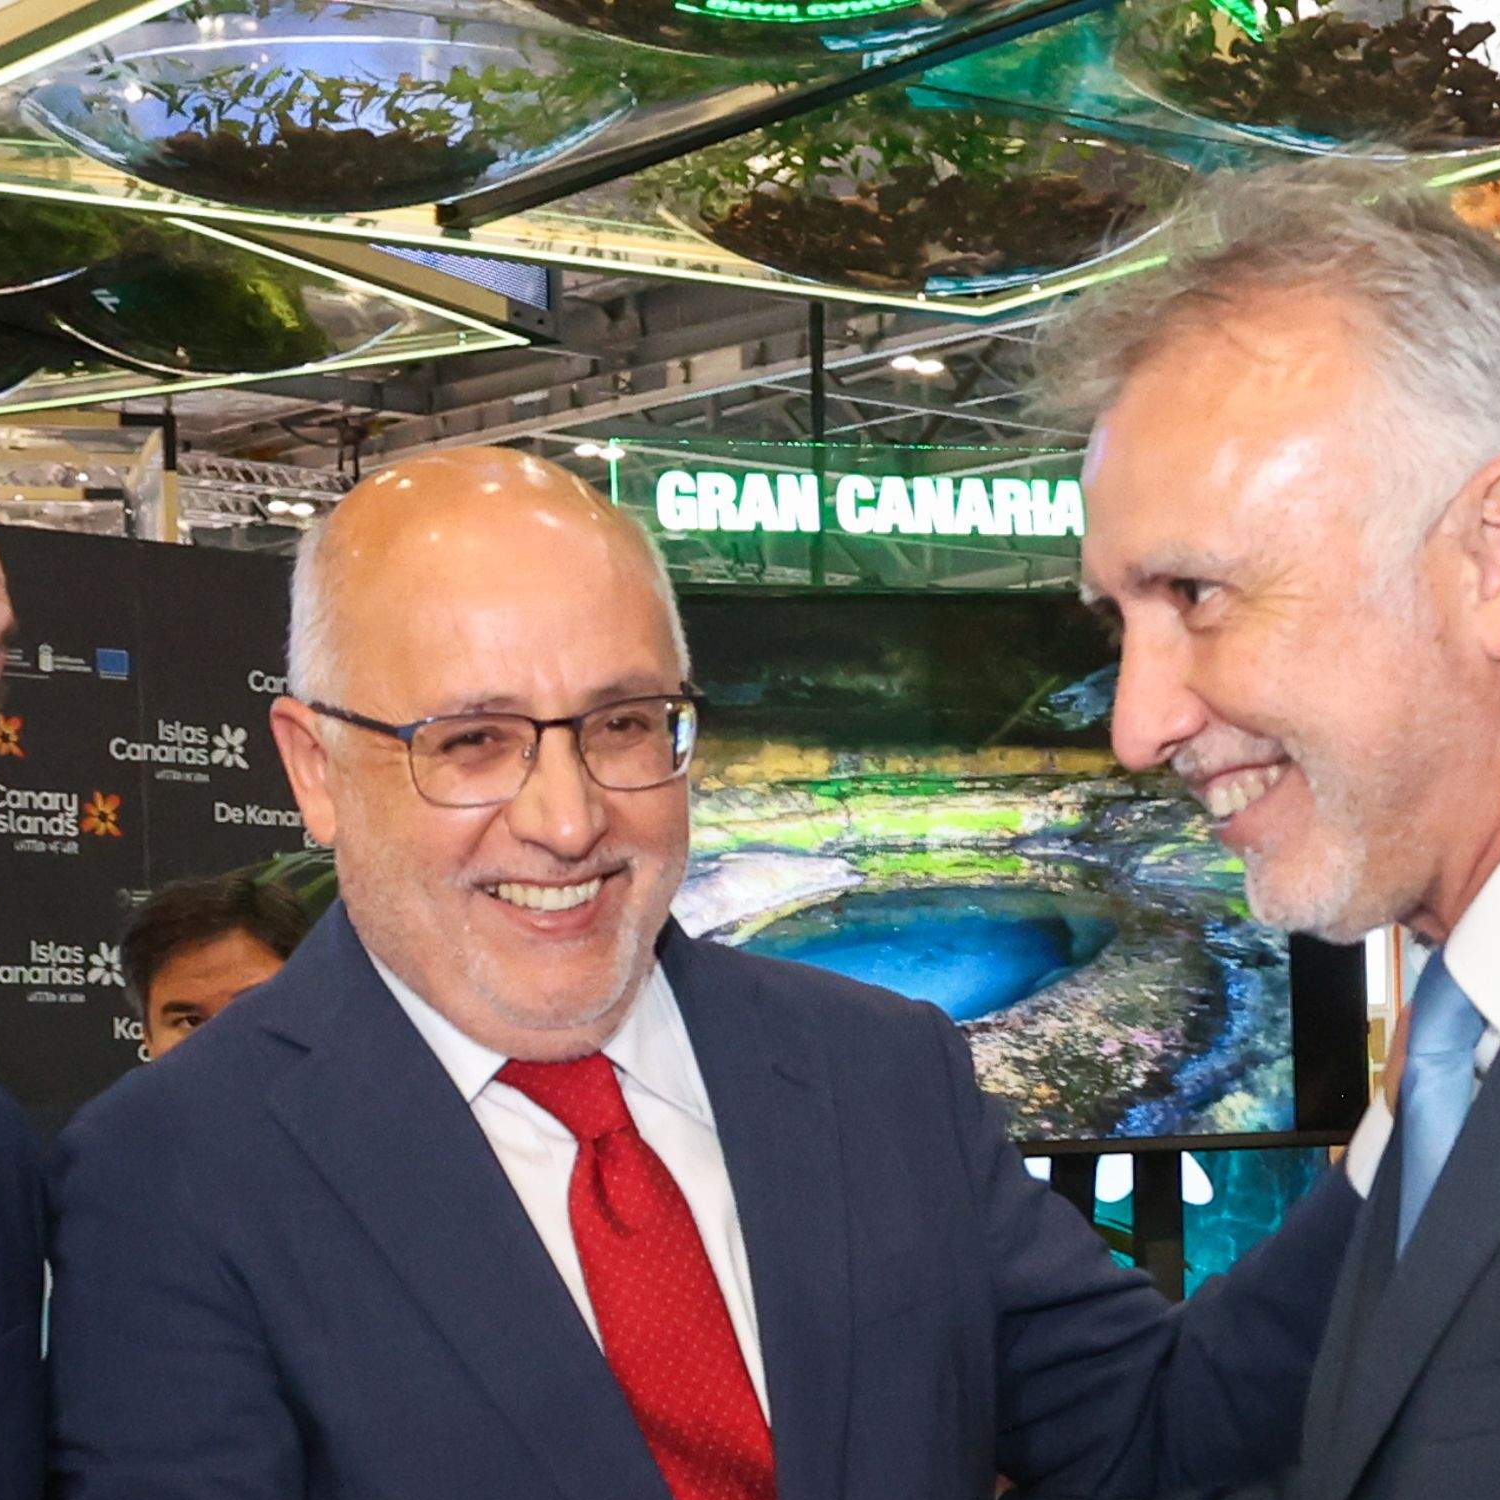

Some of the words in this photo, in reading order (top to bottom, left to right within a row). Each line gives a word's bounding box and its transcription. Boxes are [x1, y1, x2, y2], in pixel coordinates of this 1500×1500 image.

[656, 470, 822, 533] GRAN
[835, 474, 1086, 537] CANARIA
[157, 719, 209, 746] Islas
[109, 736, 210, 766] Canarias
[213, 802, 245, 824] De
[30, 939, 86, 964] Islas
